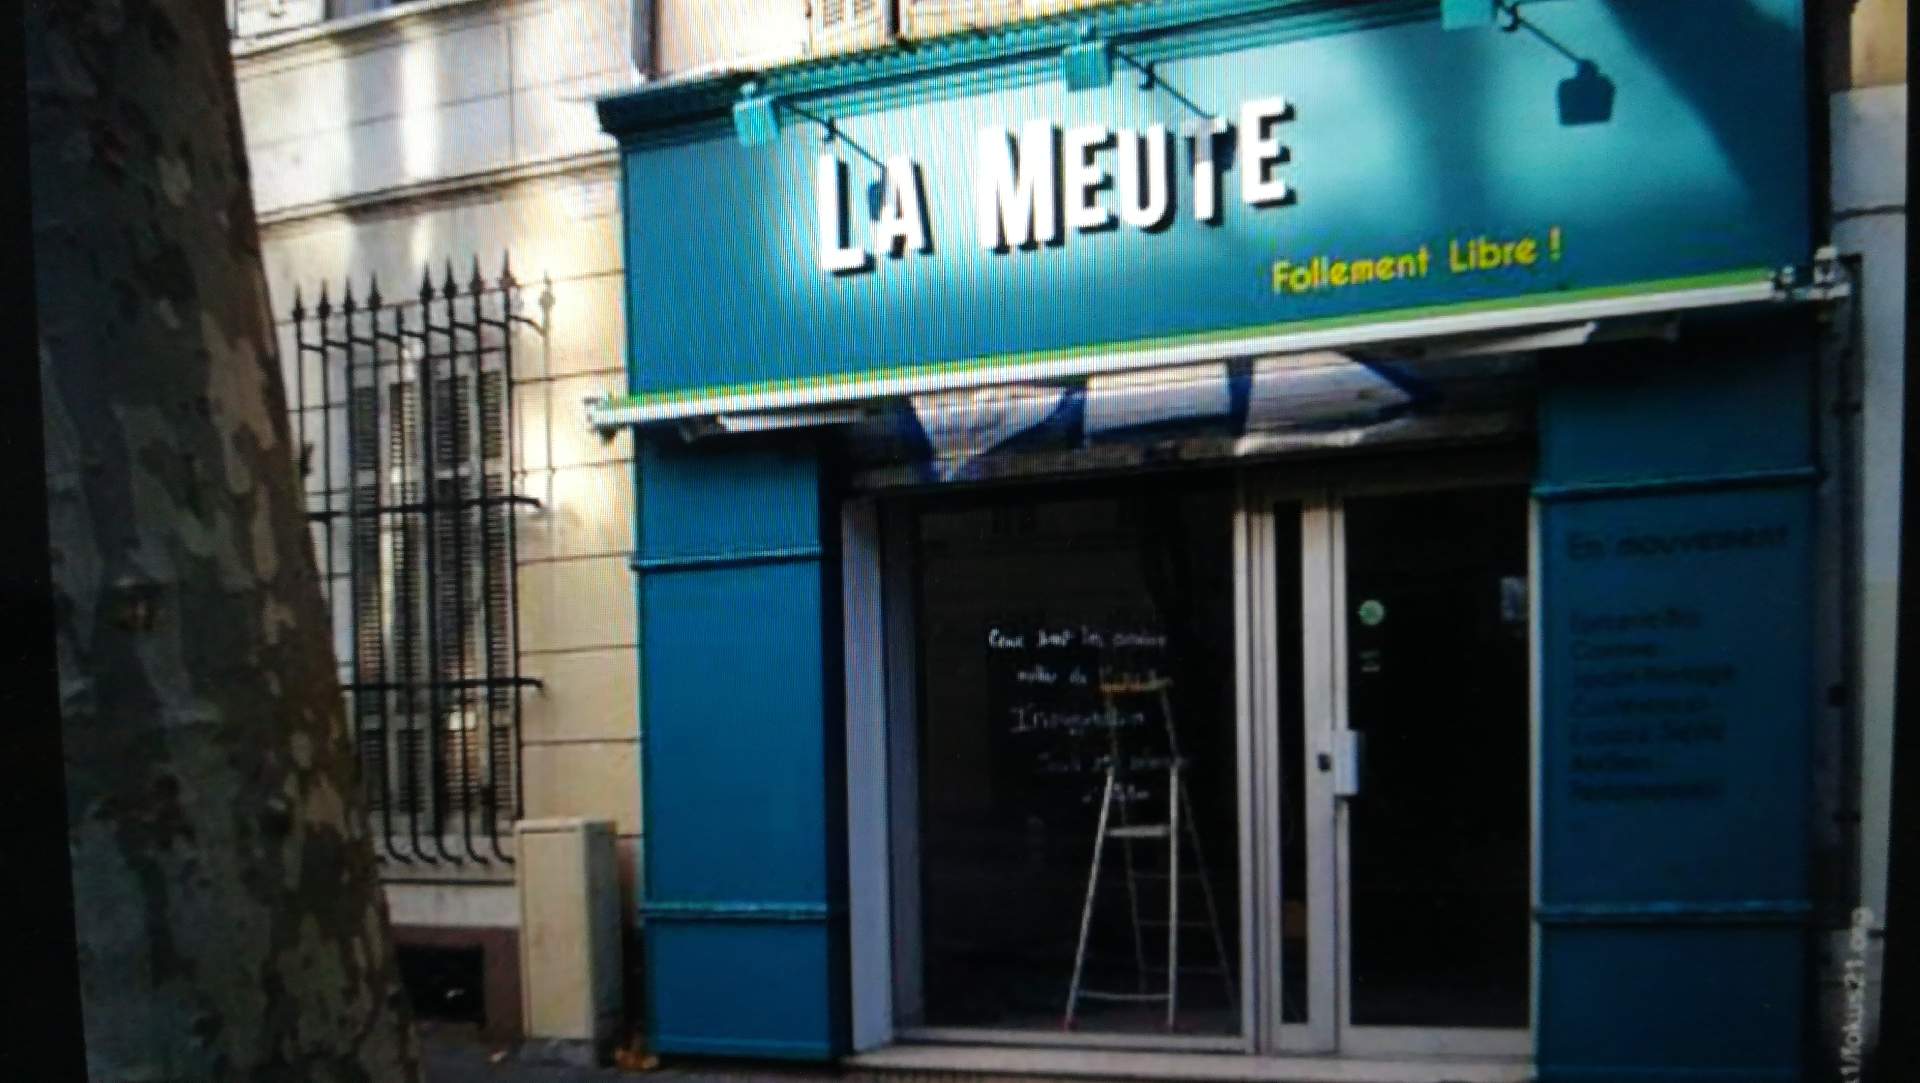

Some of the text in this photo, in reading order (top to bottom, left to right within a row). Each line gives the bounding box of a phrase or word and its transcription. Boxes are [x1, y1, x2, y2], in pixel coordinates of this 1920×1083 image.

[817, 96, 1294, 273] LA MEUTE
[1271, 245, 1430, 293] Follement
[1450, 235, 1537, 273] Libre
